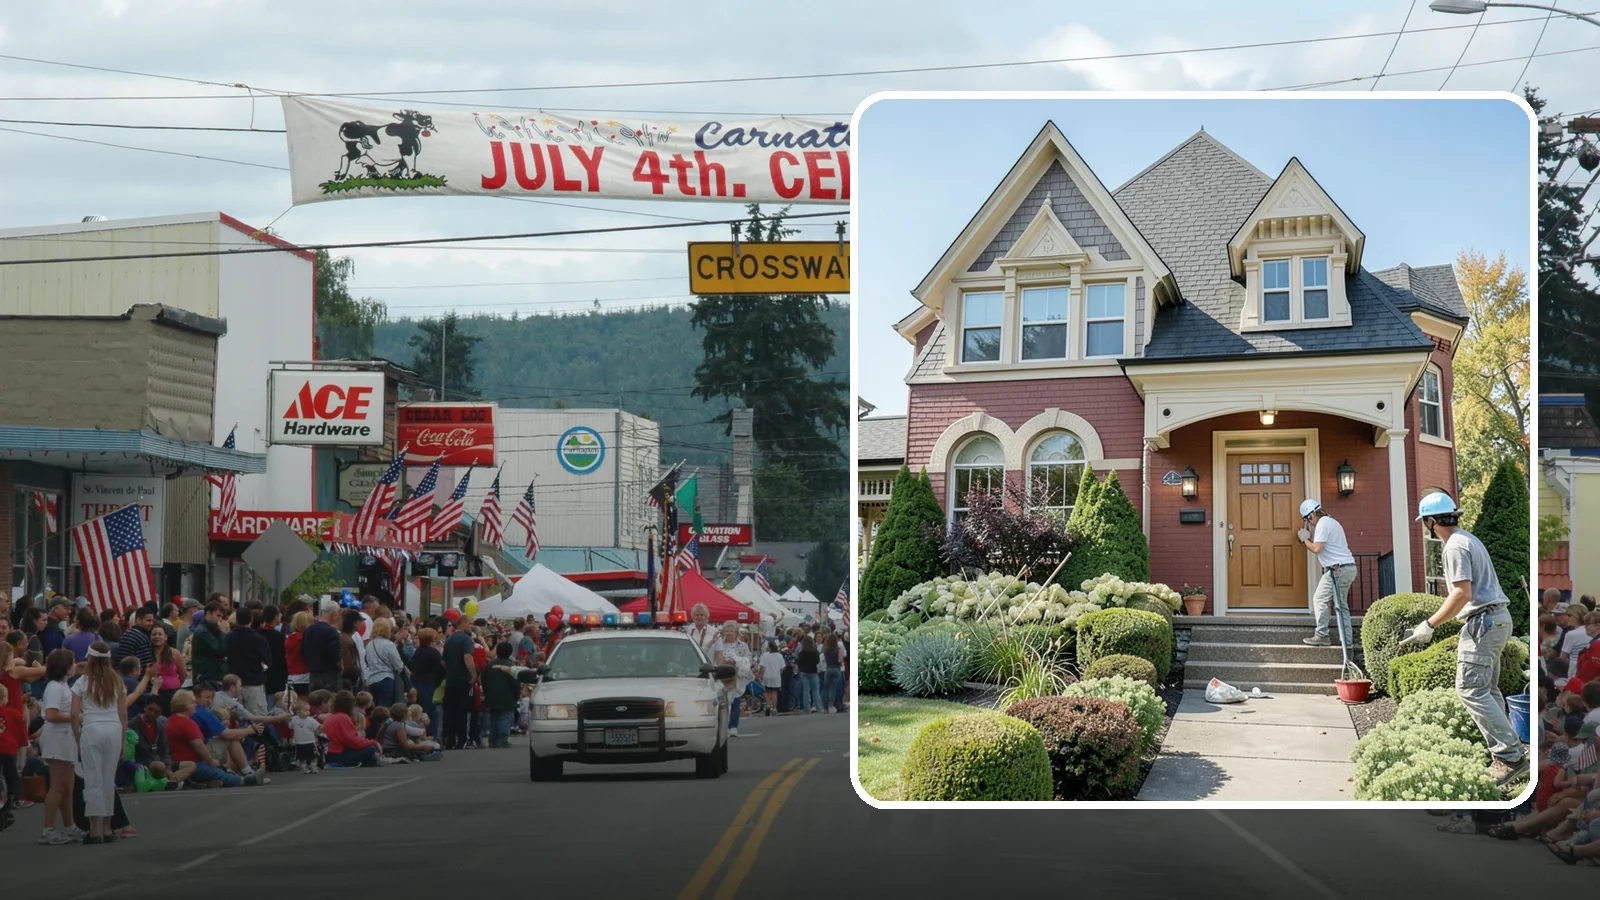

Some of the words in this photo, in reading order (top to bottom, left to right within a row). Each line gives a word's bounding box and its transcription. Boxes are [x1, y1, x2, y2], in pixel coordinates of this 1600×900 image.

[695, 121, 850, 149] Carnat
[481, 141, 604, 193] JULY
[632, 150, 746, 198] 4th.
[697, 254, 850, 280] CROSSWA
[282, 380, 374, 420] ACE
[461, 409, 485, 422] LOG
[283, 421, 370, 436] Hardware
[353, 467, 386, 480] Simpl
[95, 485, 124, 495] Vincent
[126, 486, 136, 495] de
[137, 486, 155, 495] Paul
[688, 526, 741, 535] CRNATION
